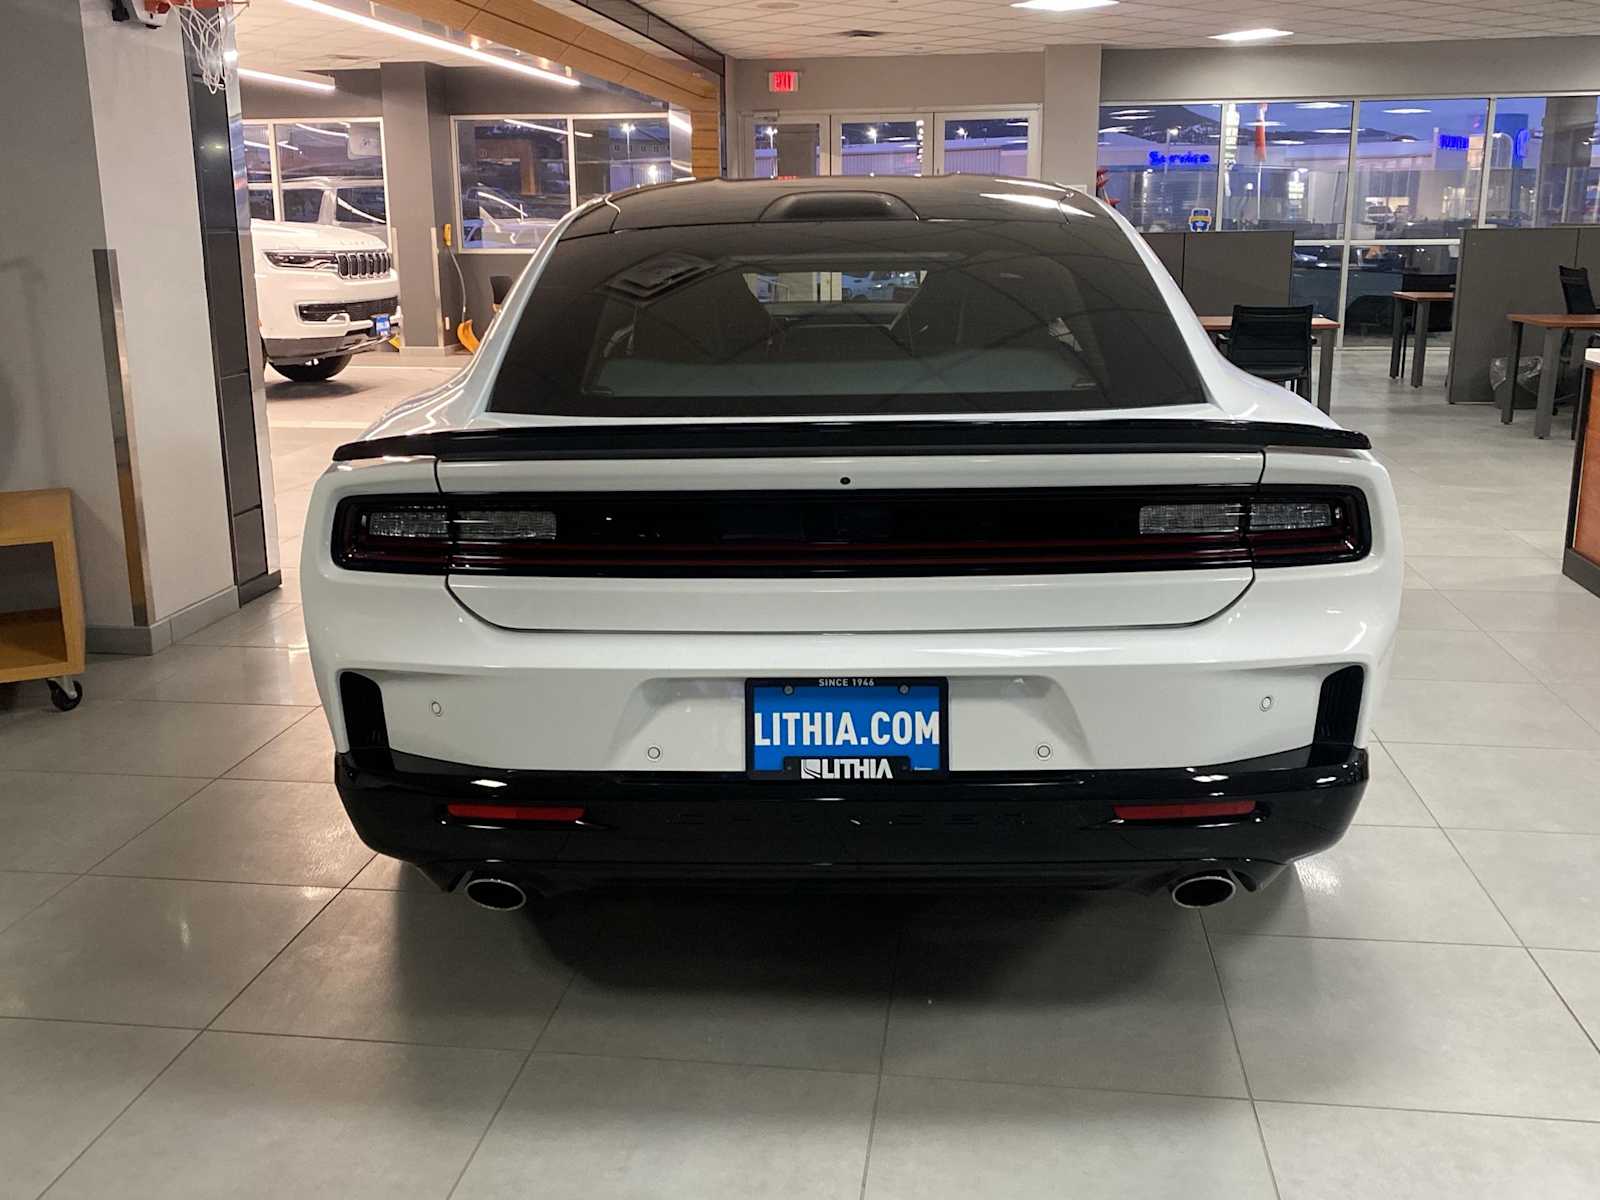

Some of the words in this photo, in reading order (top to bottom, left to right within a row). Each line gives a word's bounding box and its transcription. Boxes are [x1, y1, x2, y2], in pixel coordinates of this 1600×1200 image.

[1149, 151, 1210, 165] Service
[818, 678, 849, 687] SINCE
[852, 678, 875, 687] 1946
[754, 711, 940, 746] LITHIA.COM
[821, 758, 894, 779] LITHIA
